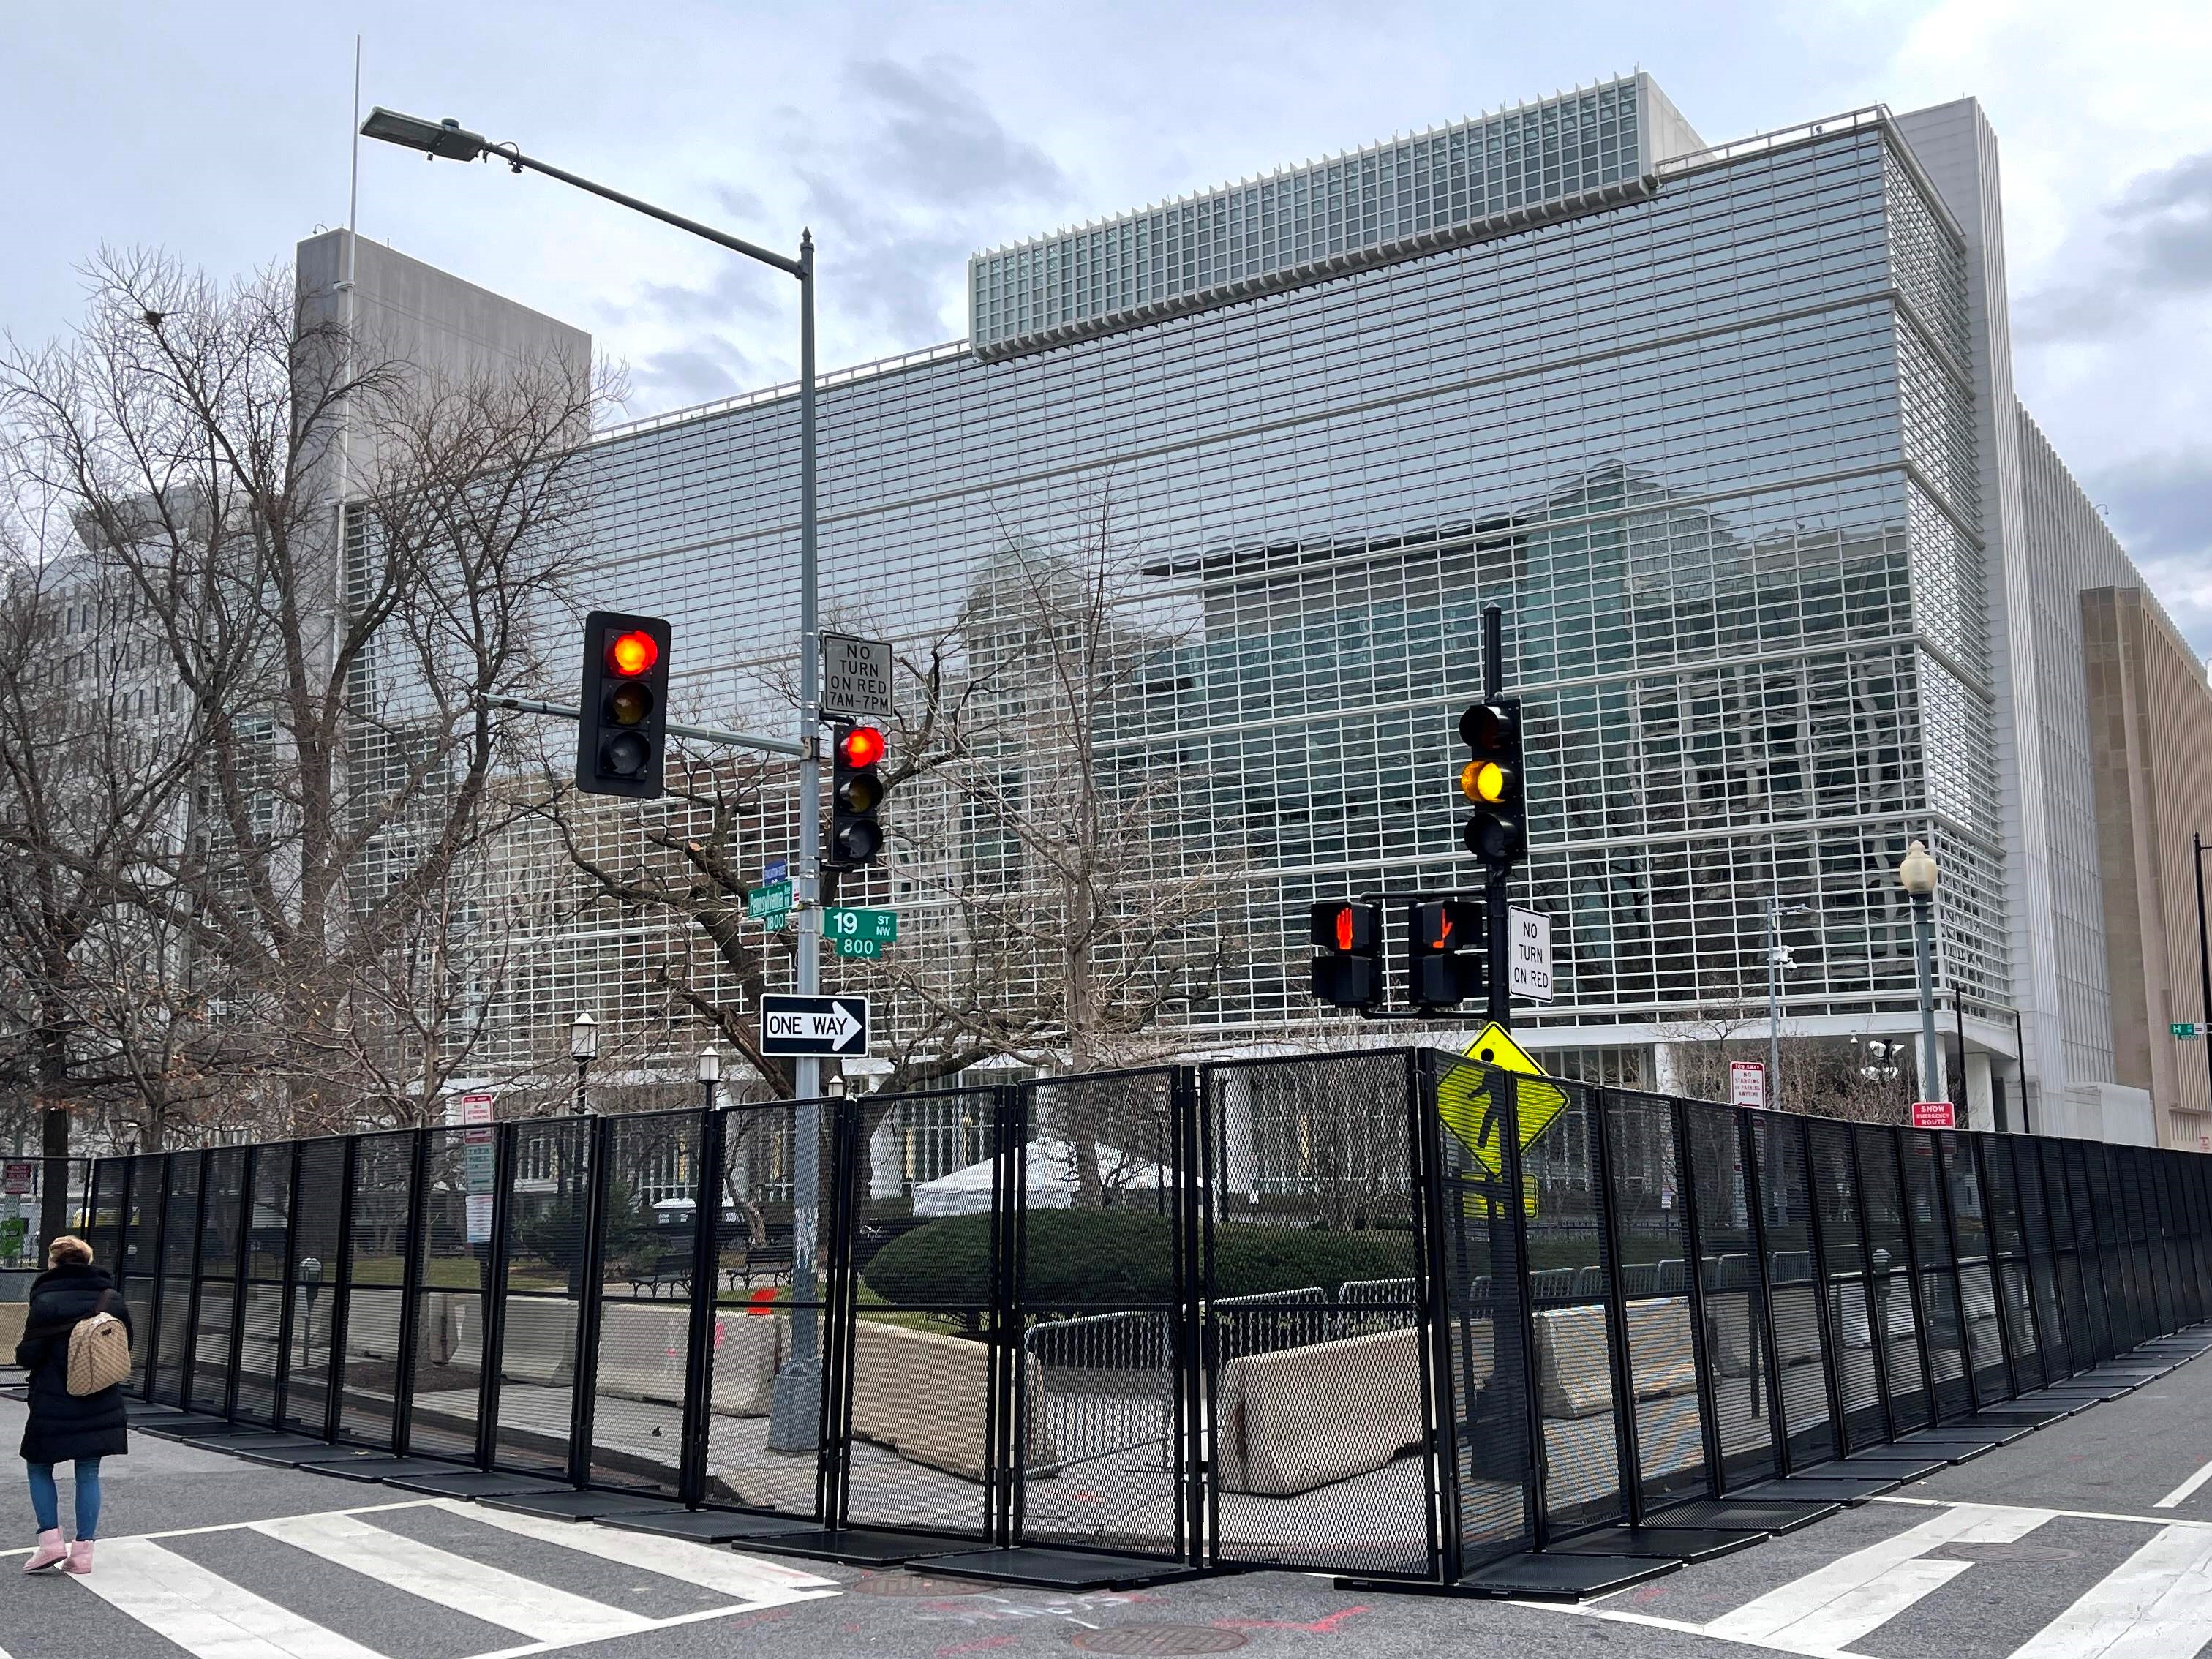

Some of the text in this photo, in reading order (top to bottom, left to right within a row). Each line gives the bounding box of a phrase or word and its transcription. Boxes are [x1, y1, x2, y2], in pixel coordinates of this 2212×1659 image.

[847, 644, 870, 659] NO
[839, 660, 878, 677] TURN
[831, 676, 887, 694] ON RED
[830, 692, 888, 711] 7AM-7PM
[750, 887, 783, 915] Pennsylvania
[833, 912, 858, 934] 19
[877, 916, 890, 925] ST
[876, 926, 891, 936] NW
[1523, 921, 1538, 938] NO
[844, 939, 873, 955] 800
[1519, 944, 1543, 963] TURN
[1514, 967, 1549, 988] ON RED
[770, 1016, 848, 1035] ONE WAY
[2173, 1025, 2181, 1033] H
